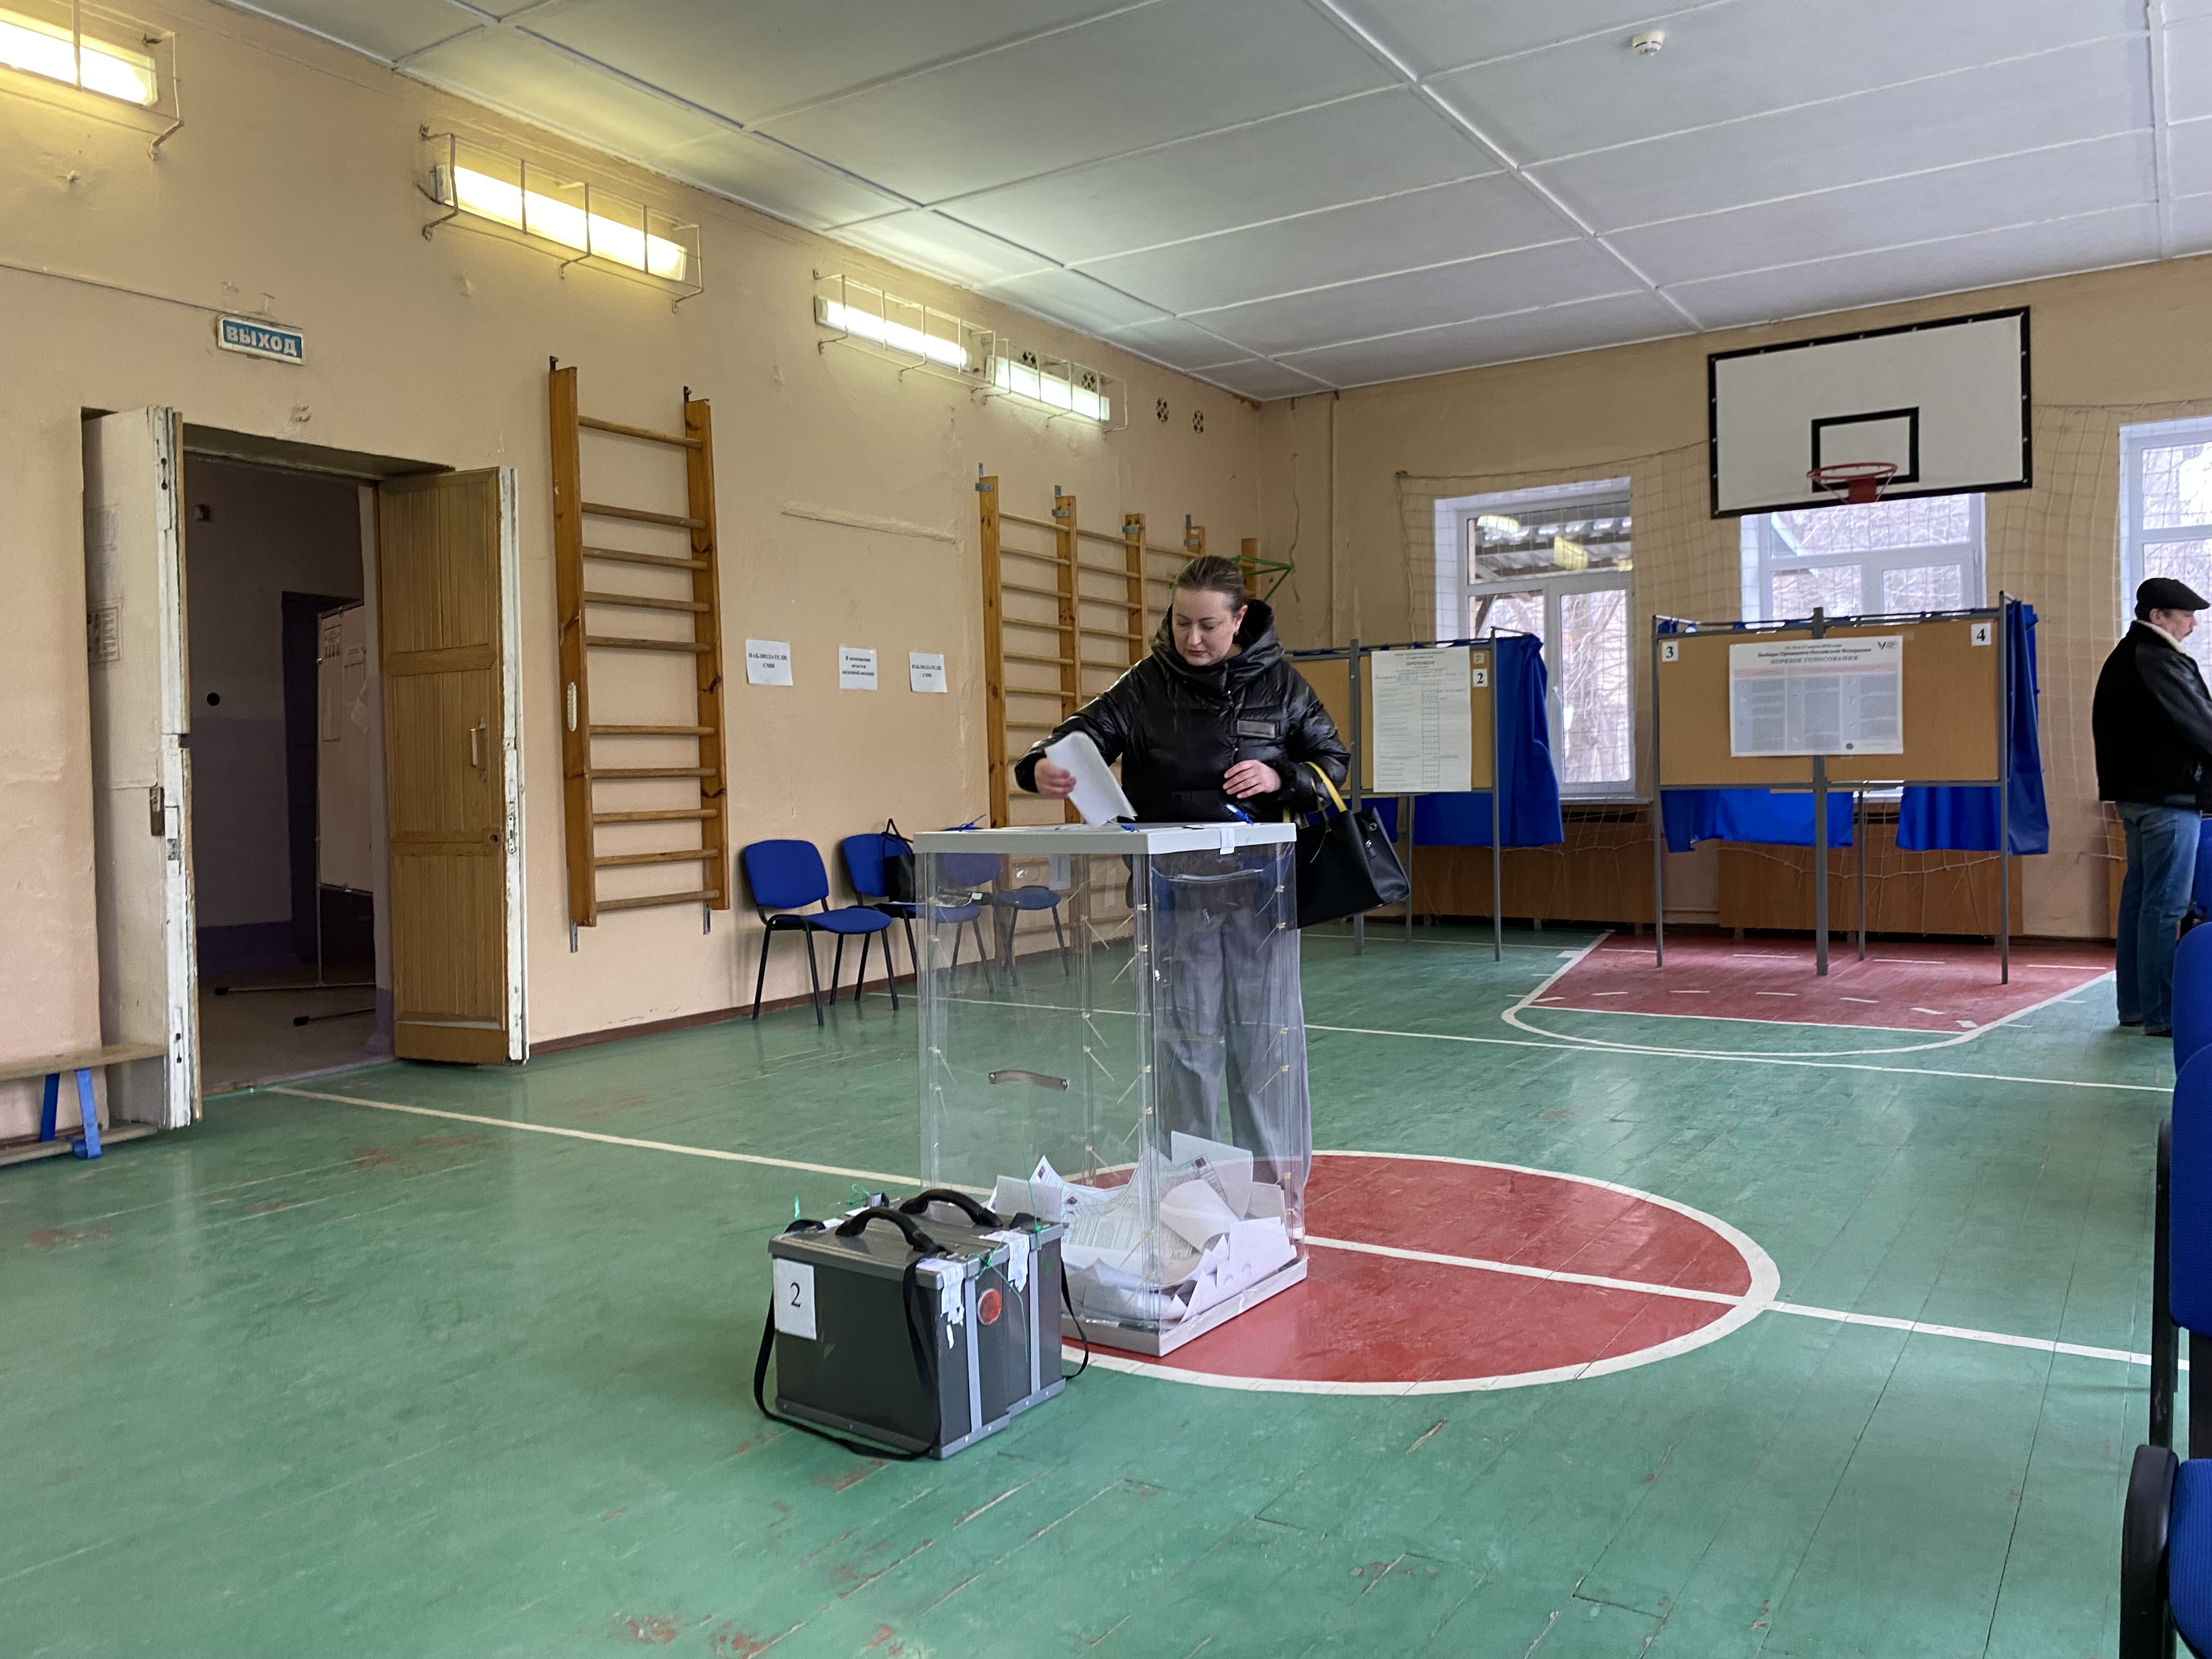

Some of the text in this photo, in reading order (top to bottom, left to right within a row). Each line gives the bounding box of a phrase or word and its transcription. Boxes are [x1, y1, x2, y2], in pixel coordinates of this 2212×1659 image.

[227, 325, 297, 356] ВЫХОД
[1977, 628, 1985, 641] 4
[1666, 646, 1673, 658] 3
[1477, 673, 1484, 684] 2
[790, 1282, 801, 1307] 2
